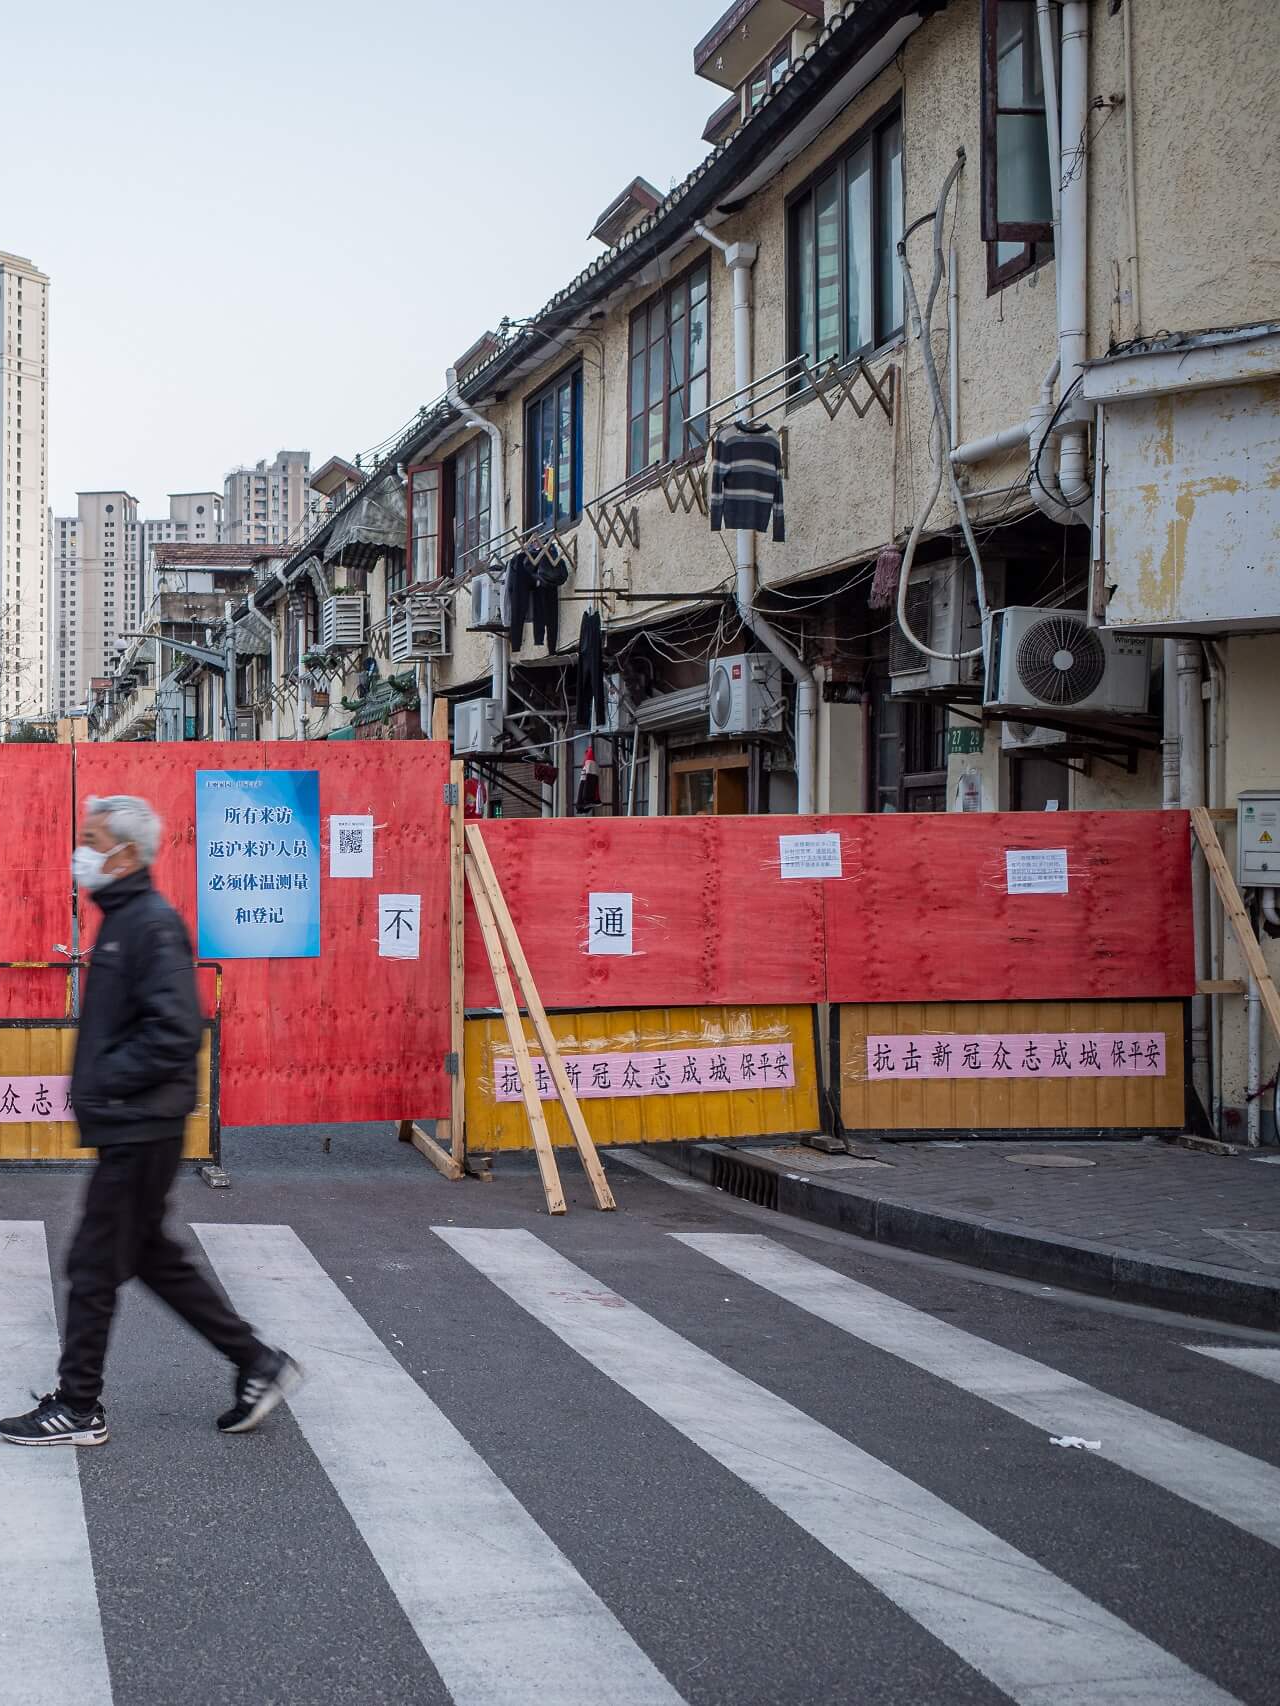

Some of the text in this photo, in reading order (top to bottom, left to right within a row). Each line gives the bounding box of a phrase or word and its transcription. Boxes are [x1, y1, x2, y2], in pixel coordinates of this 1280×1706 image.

[952, 730, 962, 745] 27
[224, 807, 293, 825] 所有来访
[208, 840, 308, 858] 返沪来沪人员
[208, 873, 309, 891] 必须体温测量
[234, 906, 285, 925] 和登记
[384, 908, 415, 940] 不
[594, 906, 626, 937] 通
